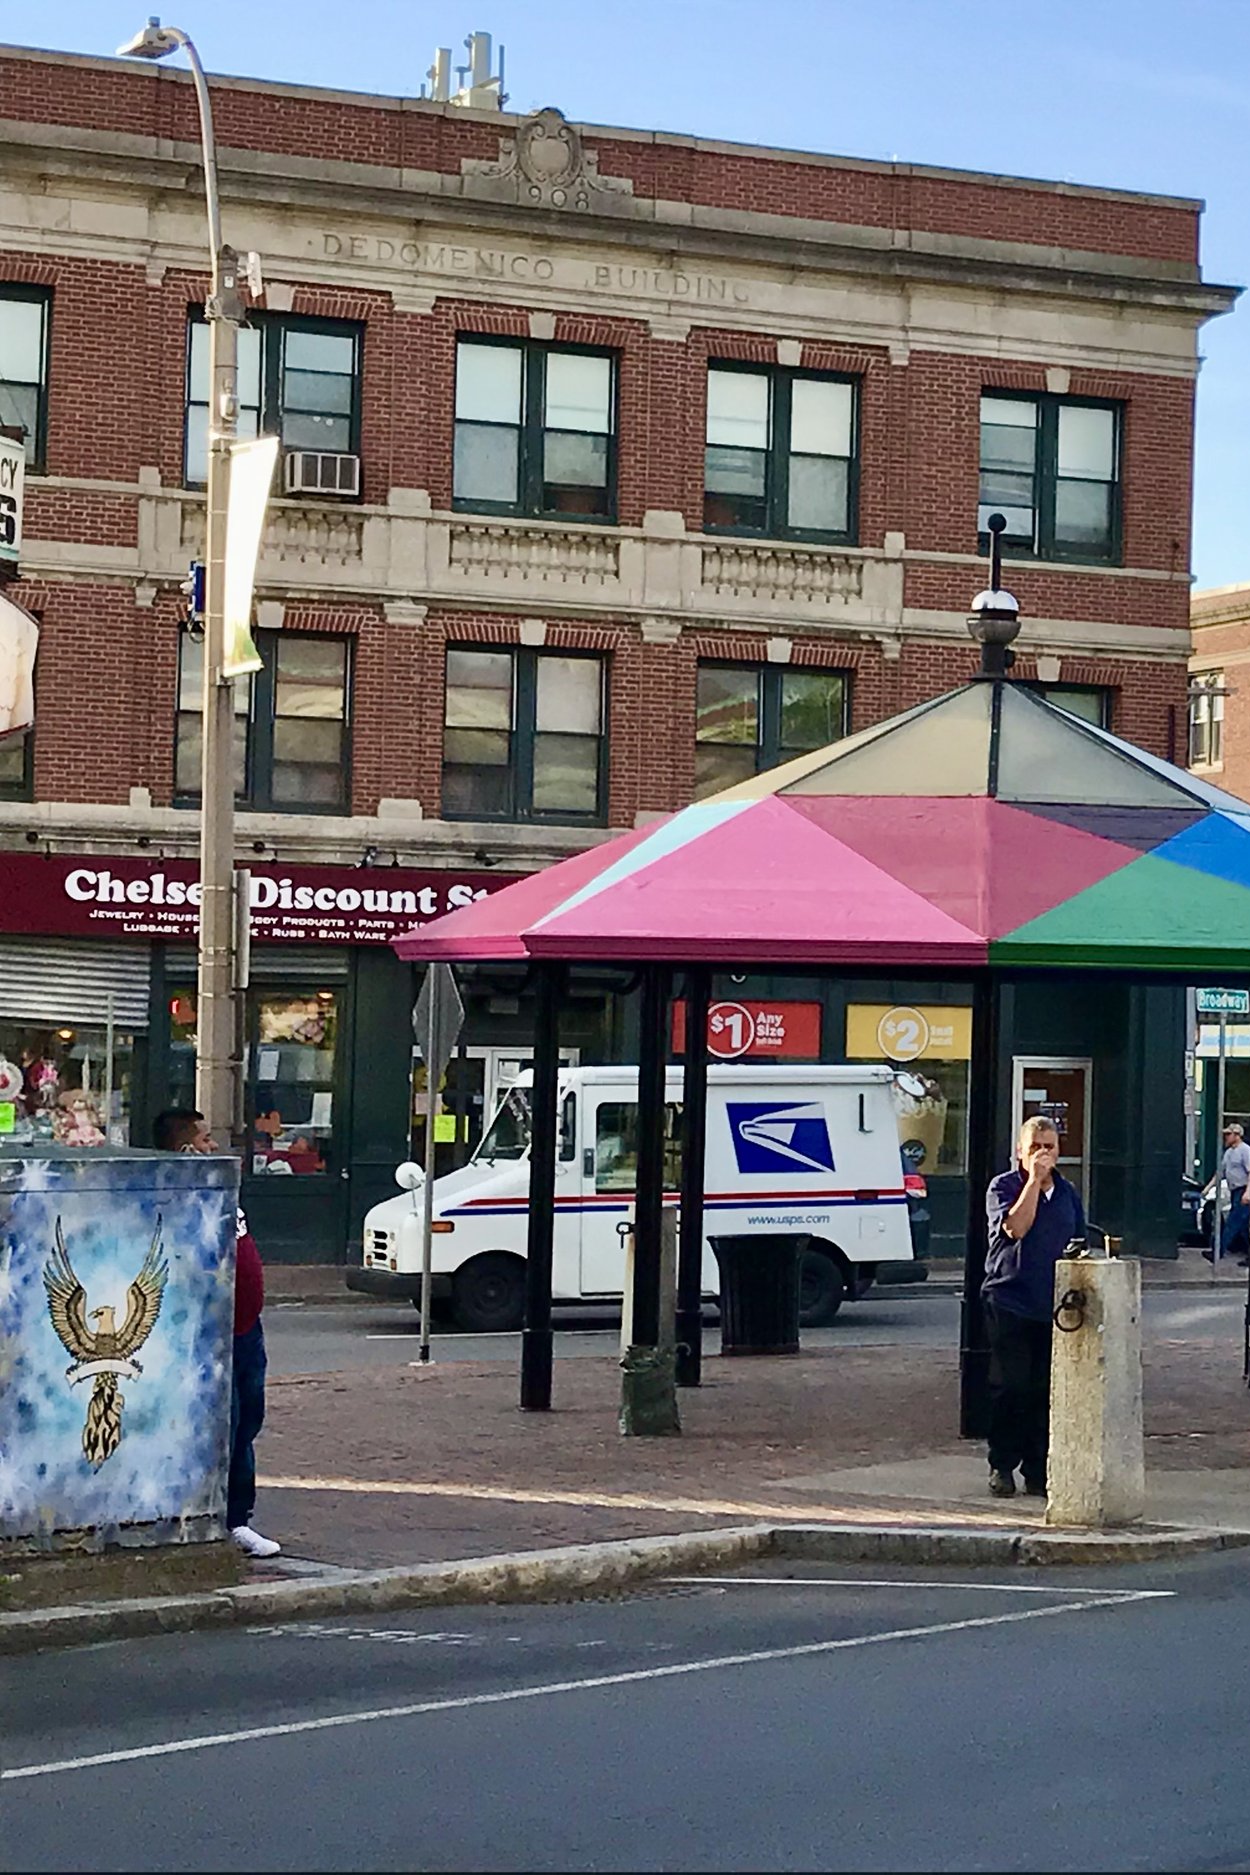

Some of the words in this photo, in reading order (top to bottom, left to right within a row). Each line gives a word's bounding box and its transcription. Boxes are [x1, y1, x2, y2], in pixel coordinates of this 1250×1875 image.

[322, 233, 554, 281] DEDOMENICO
[64, 869, 201, 906] Chelse
[250, 876, 437, 915] Discount
[89, 909, 145, 920] JEWELRY
[282, 916, 345, 927] PRODUCTS
[358, 919, 395, 929] PARTS
[710, 1013, 743, 1049] $1
[756, 1011, 784, 1027] Any
[756, 1024, 785, 1037] Size
[885, 1019, 920, 1052] $2
